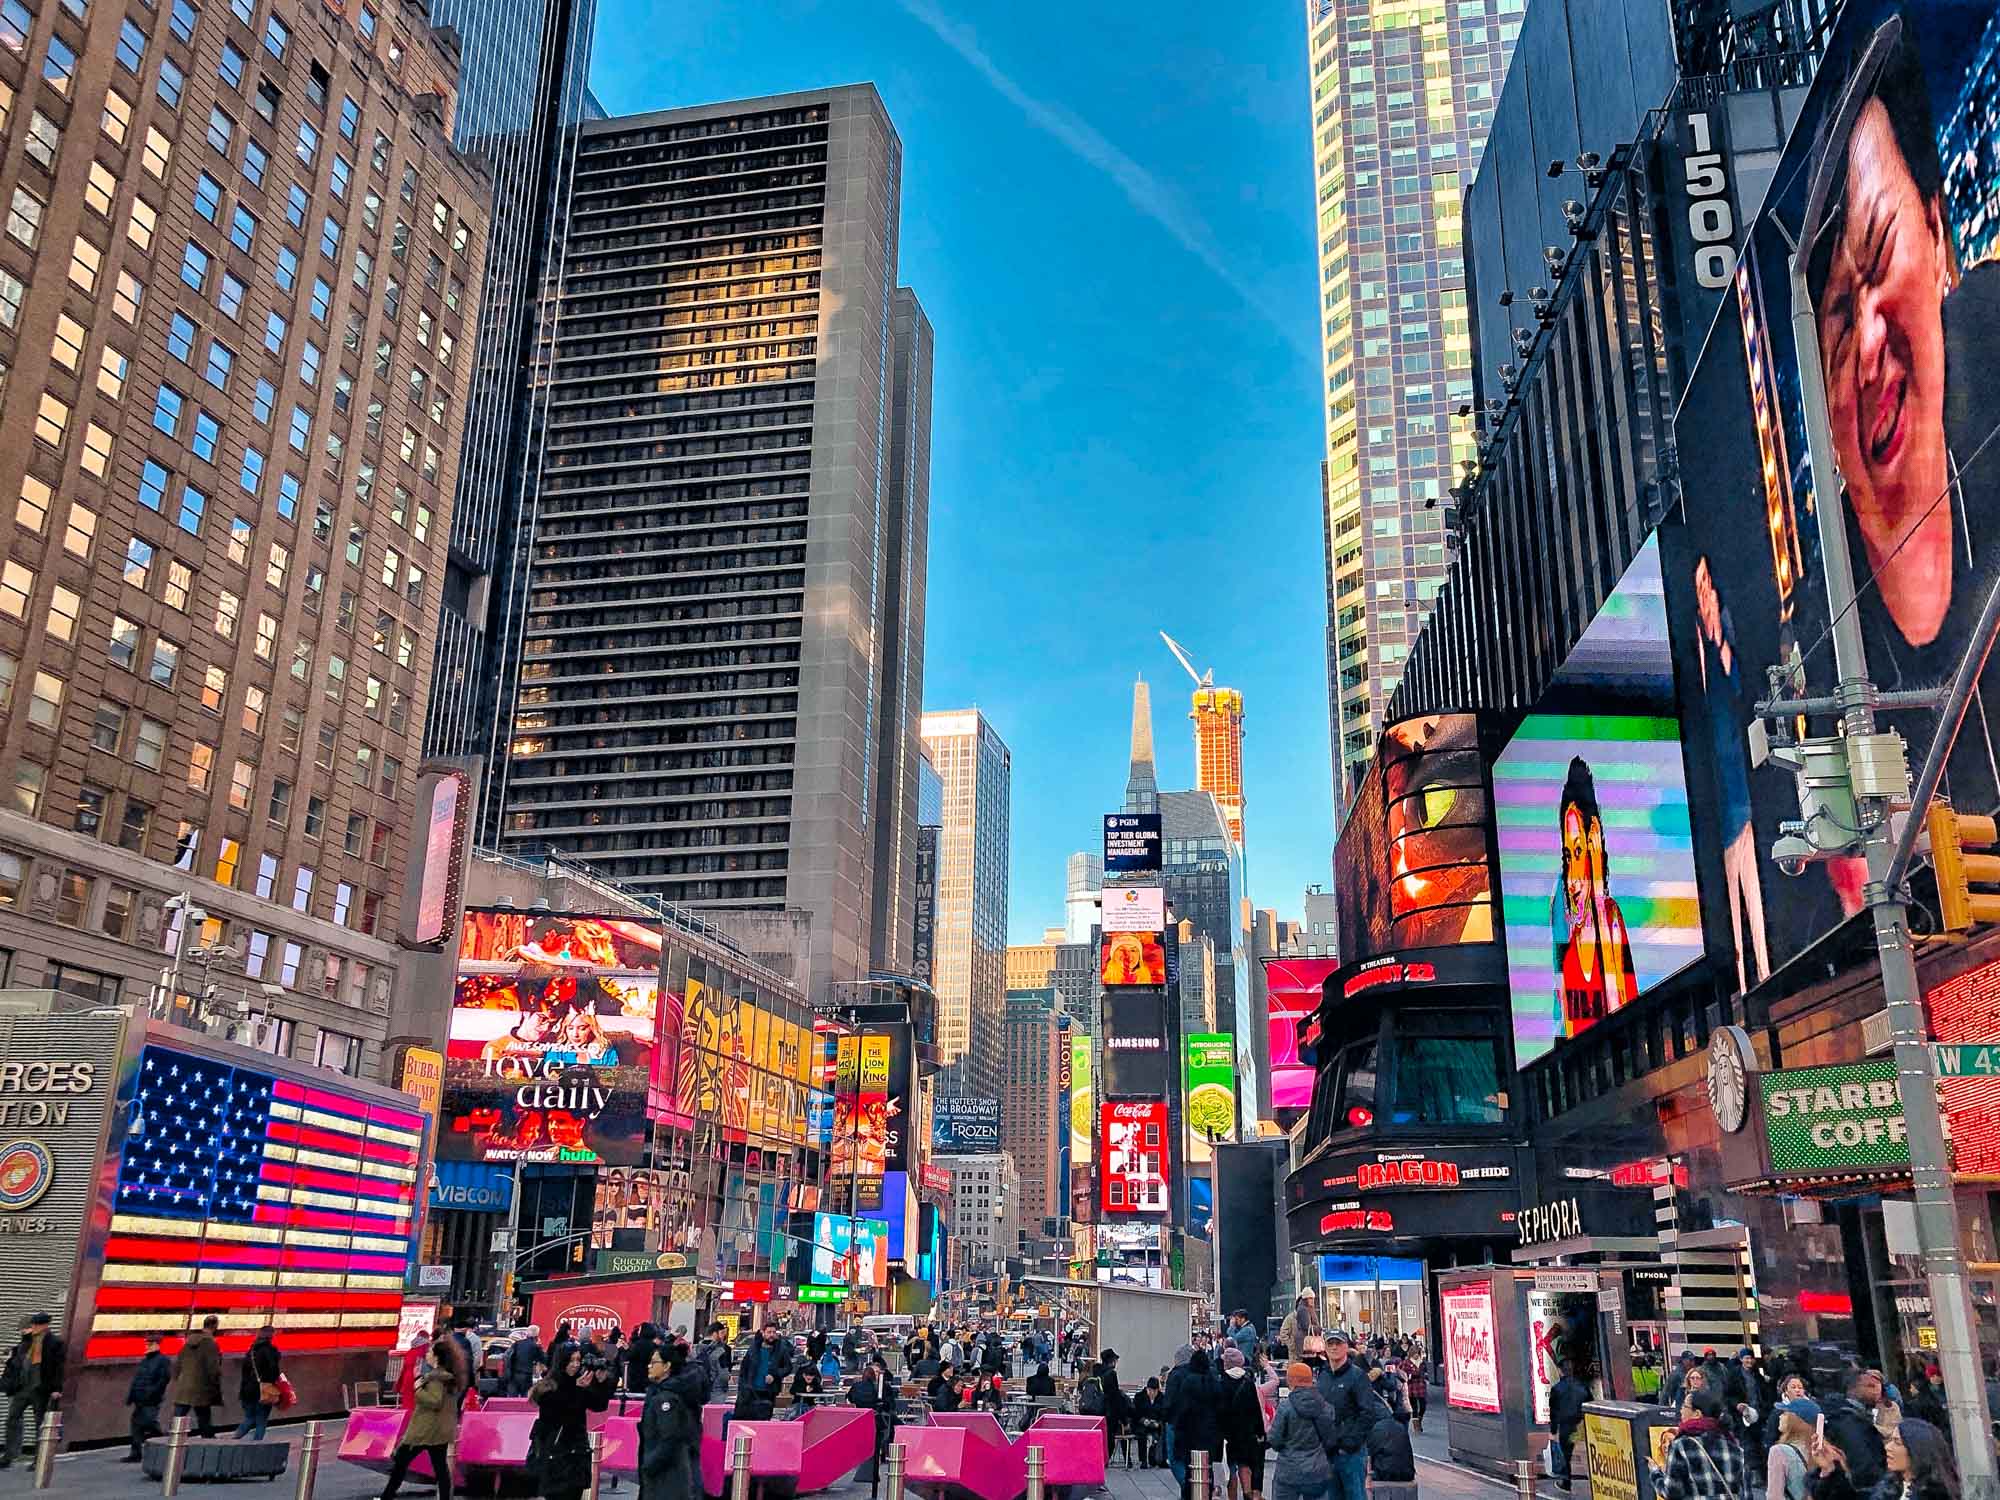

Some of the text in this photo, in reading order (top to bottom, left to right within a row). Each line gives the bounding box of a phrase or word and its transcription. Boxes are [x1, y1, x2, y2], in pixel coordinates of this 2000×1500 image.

[1685, 113, 1737, 289] 1500
[1107, 848, 1149, 856] MANAGEMENT
[407, 1056, 440, 1080] BUBBA
[484, 1047, 564, 1081] love
[865, 1058, 884, 1068] LION
[1940, 1047, 1960, 1073] W
[863, 1071, 887, 1083] KING
[516, 1079, 613, 1119] daily
[936, 1105, 948, 1113] ON
[1769, 1078, 1902, 1117] STARB
[952, 1122, 997, 1139] FROZEN
[1811, 1115, 1906, 1148] COFF
[527, 1152, 554, 1161] NOW
[560, 1148, 597, 1161] hulu
[1358, 1161, 1460, 1190] DRAGON
[1461, 1169, 1480, 1178] THE
[1518, 1197, 1581, 1244] SEPHORA
[613, 1257, 652, 1265] CHICKEN
[559, 1317, 618, 1330] STRAND
